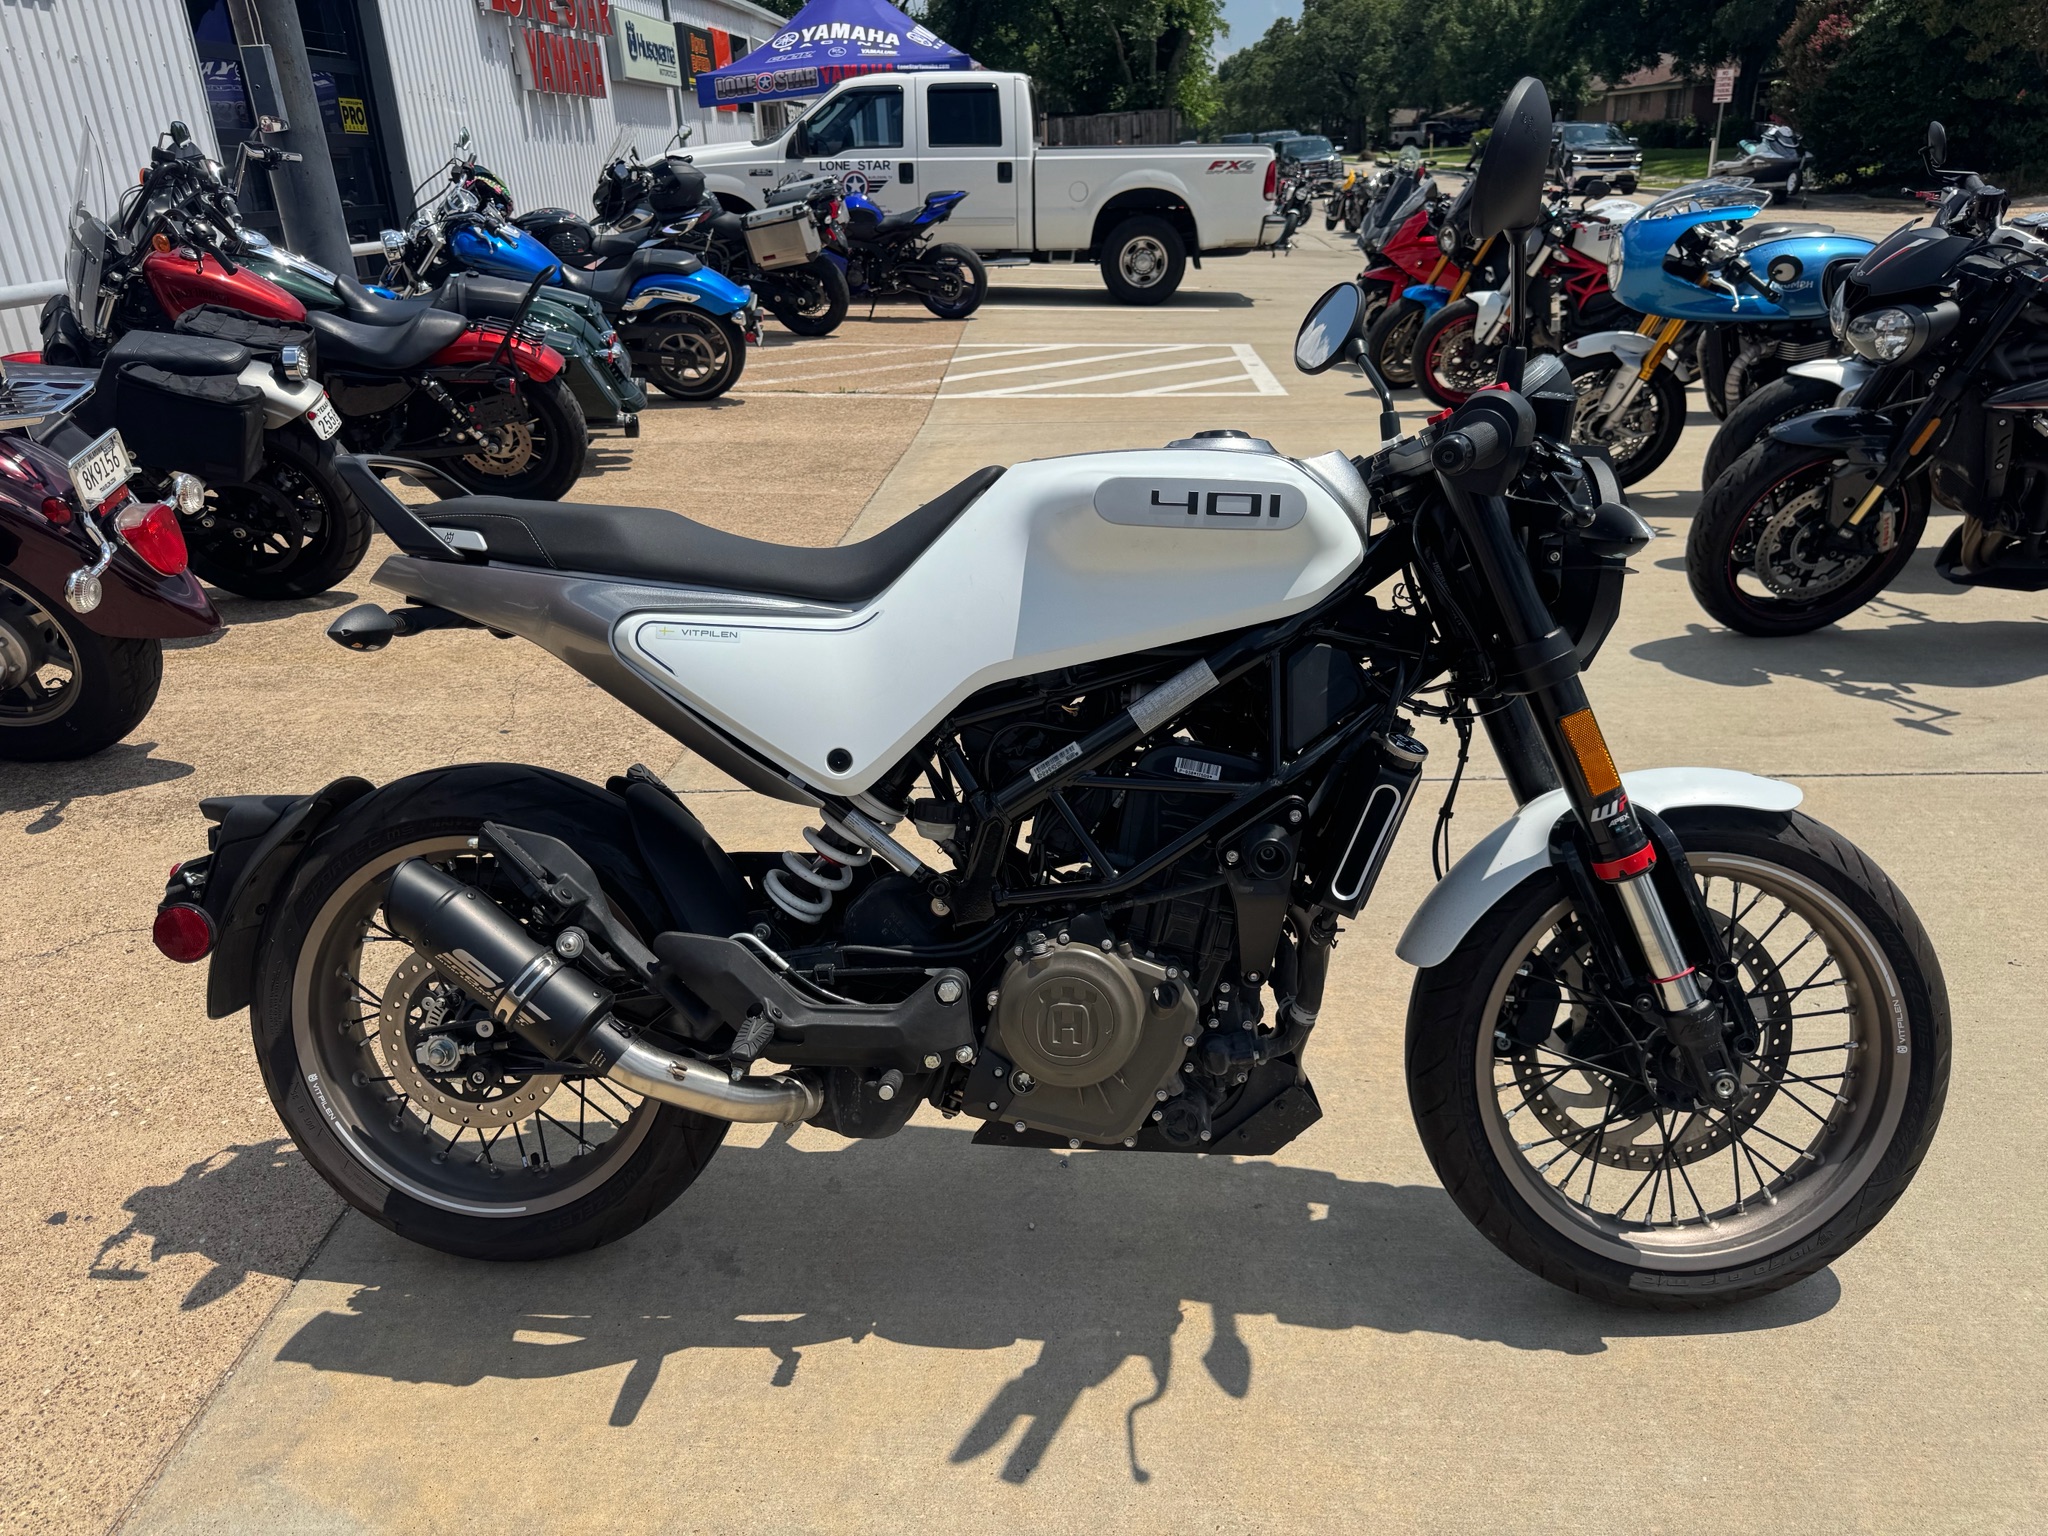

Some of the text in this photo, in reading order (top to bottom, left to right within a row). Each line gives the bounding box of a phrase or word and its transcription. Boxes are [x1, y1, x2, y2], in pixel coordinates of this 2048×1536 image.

[801, 23, 900, 46] YAMAHA
[521, 26, 607, 99] YAMAHA
[715, 74, 757, 99] LONE
[774, 67, 819, 92] STAR
[342, 106, 365, 125] PRO
[819, 160, 891, 171] LONE STAR
[1208, 160, 1256, 171] FX4
[1599, 223, 1622, 232] DUCA
[82, 448, 120, 491] 8K9156
[1151, 490, 1281, 518] 401
[681, 629, 738, 638] VITPILEN
[1591, 794, 1628, 822] WP
[1608, 812, 1631, 828] APEX
[1892, 999, 1906, 1044] VITPILEN
[312, 1081, 337, 1121] VITPILEN
